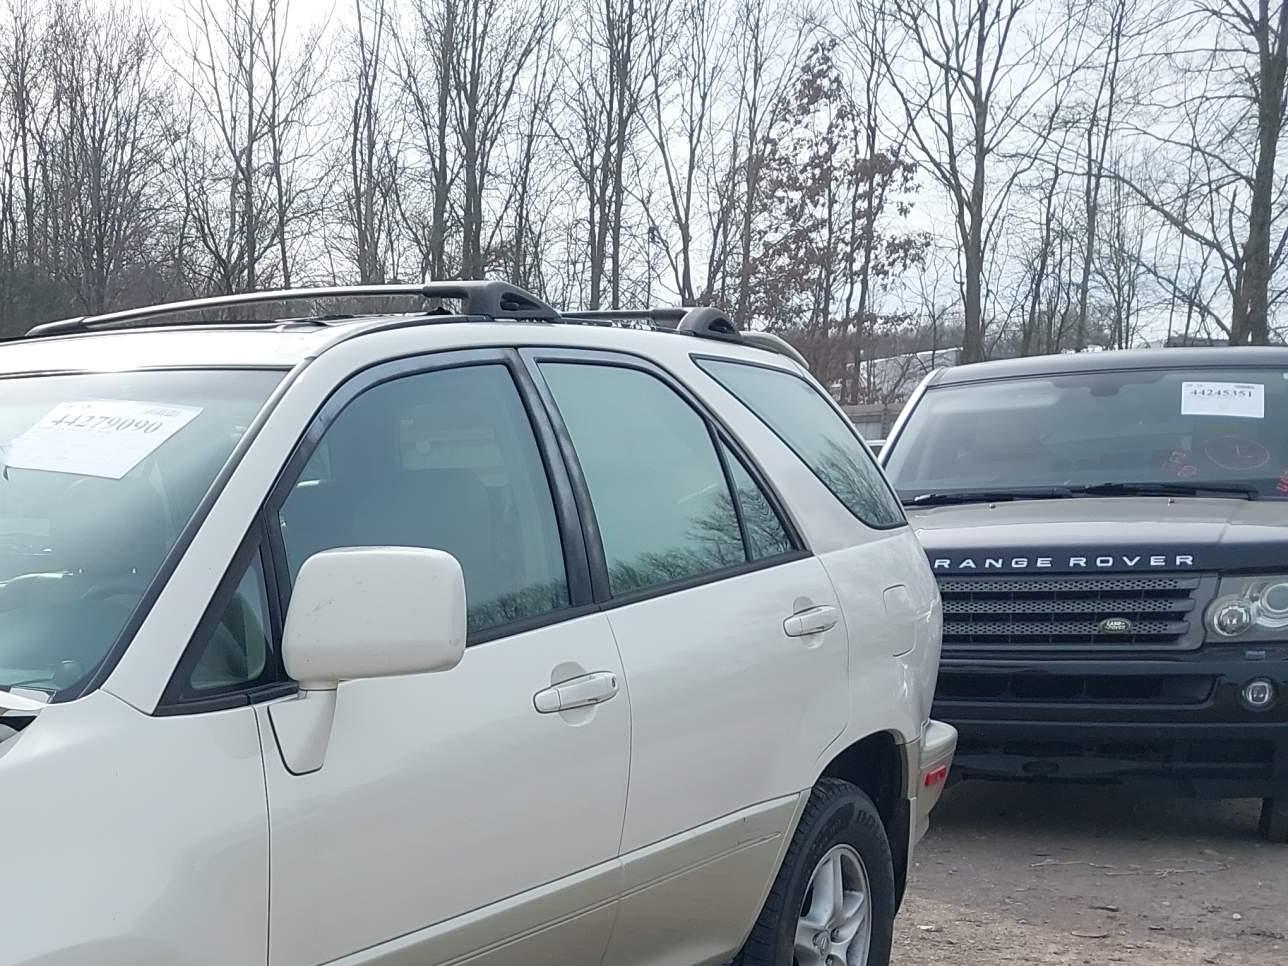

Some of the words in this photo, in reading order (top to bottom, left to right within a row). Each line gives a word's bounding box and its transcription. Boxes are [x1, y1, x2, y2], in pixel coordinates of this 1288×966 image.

[52, 413, 164, 434] 44279090
[933, 556, 1053, 570] RANGE
[1068, 554, 1194, 569] ROVER
